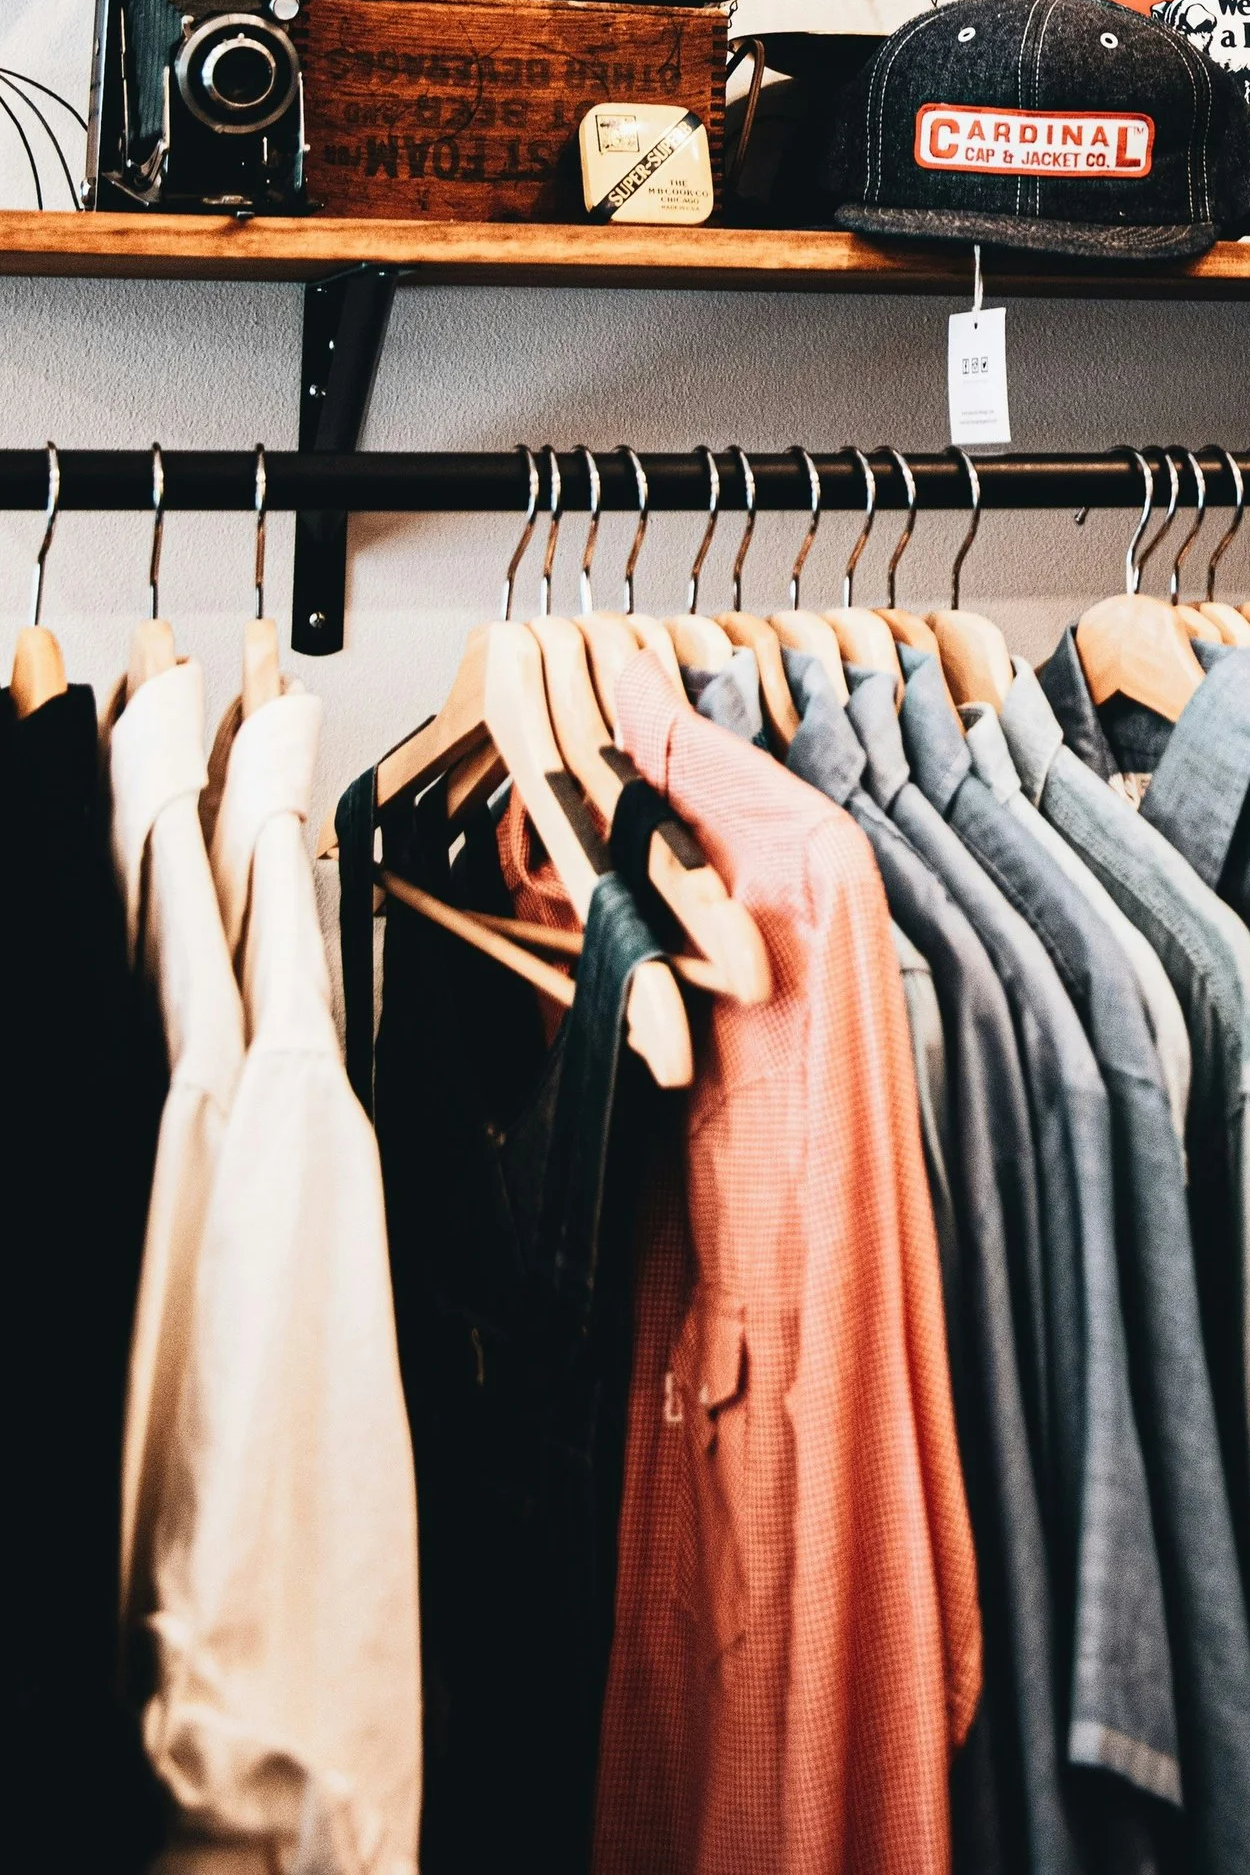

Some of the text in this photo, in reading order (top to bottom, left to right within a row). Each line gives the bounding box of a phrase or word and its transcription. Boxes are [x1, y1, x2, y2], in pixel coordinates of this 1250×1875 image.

[1221, 30, 1238, 48] a
[929, 118, 1141, 168] CARDINAL
[965, 147, 1111, 169] CAP & JACKET CO.
[608, 120, 693, 207] SUPER-SUPB
